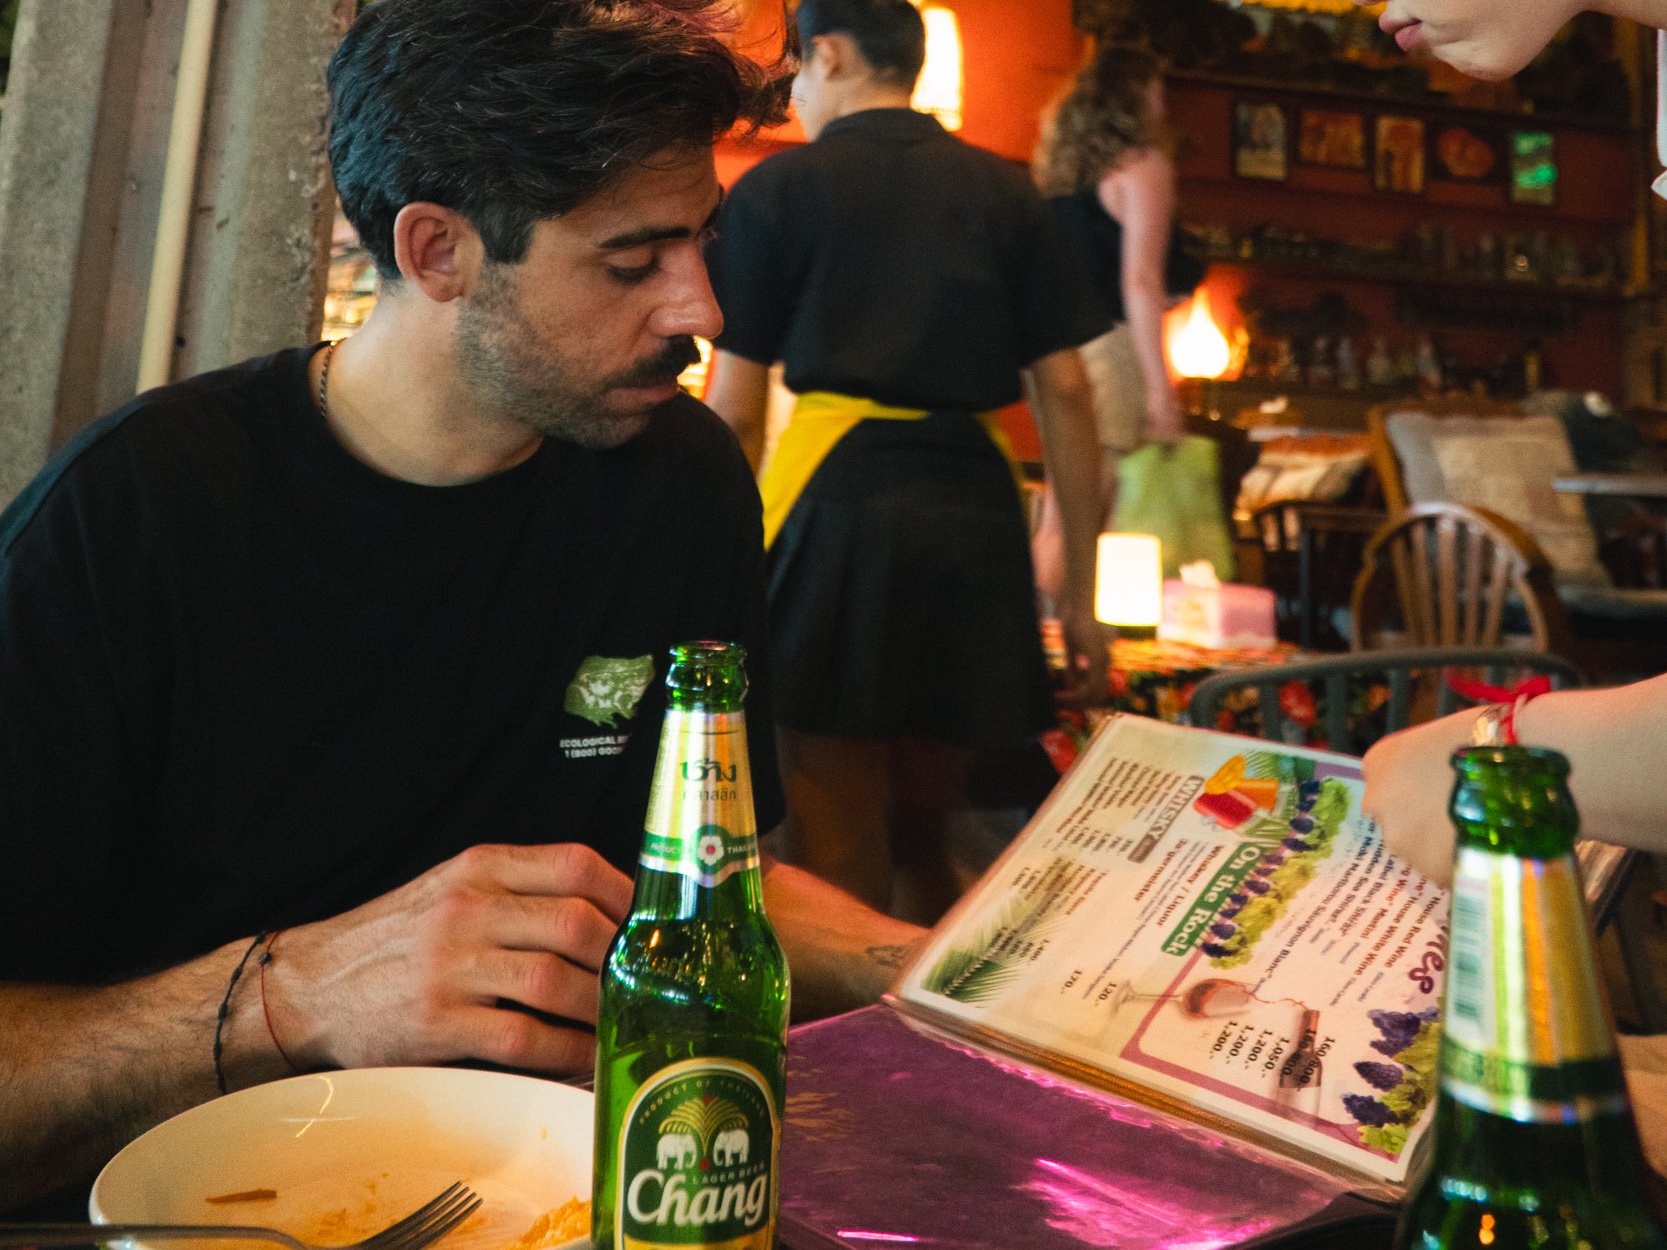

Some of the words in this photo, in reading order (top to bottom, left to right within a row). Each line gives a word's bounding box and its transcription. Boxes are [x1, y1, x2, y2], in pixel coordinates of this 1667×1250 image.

[559, 736, 617, 748] ECOLOGICAL
[1144, 777, 1202, 840] WHISKY
[650, 842, 679, 855] PRODUC
[1185, 844, 1224, 885] Whiskey
[1227, 844, 1262, 871] On
[1378, 853, 1398, 881] Label
[1201, 872, 1236, 905] the
[1154, 894, 1185, 927] Liquor
[1359, 907, 1389, 940] Martini
[1392, 895, 1418, 924] House
[1415, 895, 1441, 925] House
[1164, 906, 1212, 957] Rock
[1284, 905, 1327, 948] Sauvignon
[1371, 924, 1398, 952] White
[1401, 925, 1421, 945] Red
[1352, 951, 1378, 977] Wine
[1383, 944, 1409, 969] Wine
[1205, 1019, 1237, 1061] 1,200.-
[1222, 1023, 1254, 1065] 1,200.-
[1240, 1027, 1272, 1071] 1,200.-
[639, 1081, 688, 1125] PRODUCT
[692, 1172, 736, 1186] LAGER
[627, 1168, 768, 1227] Chang
